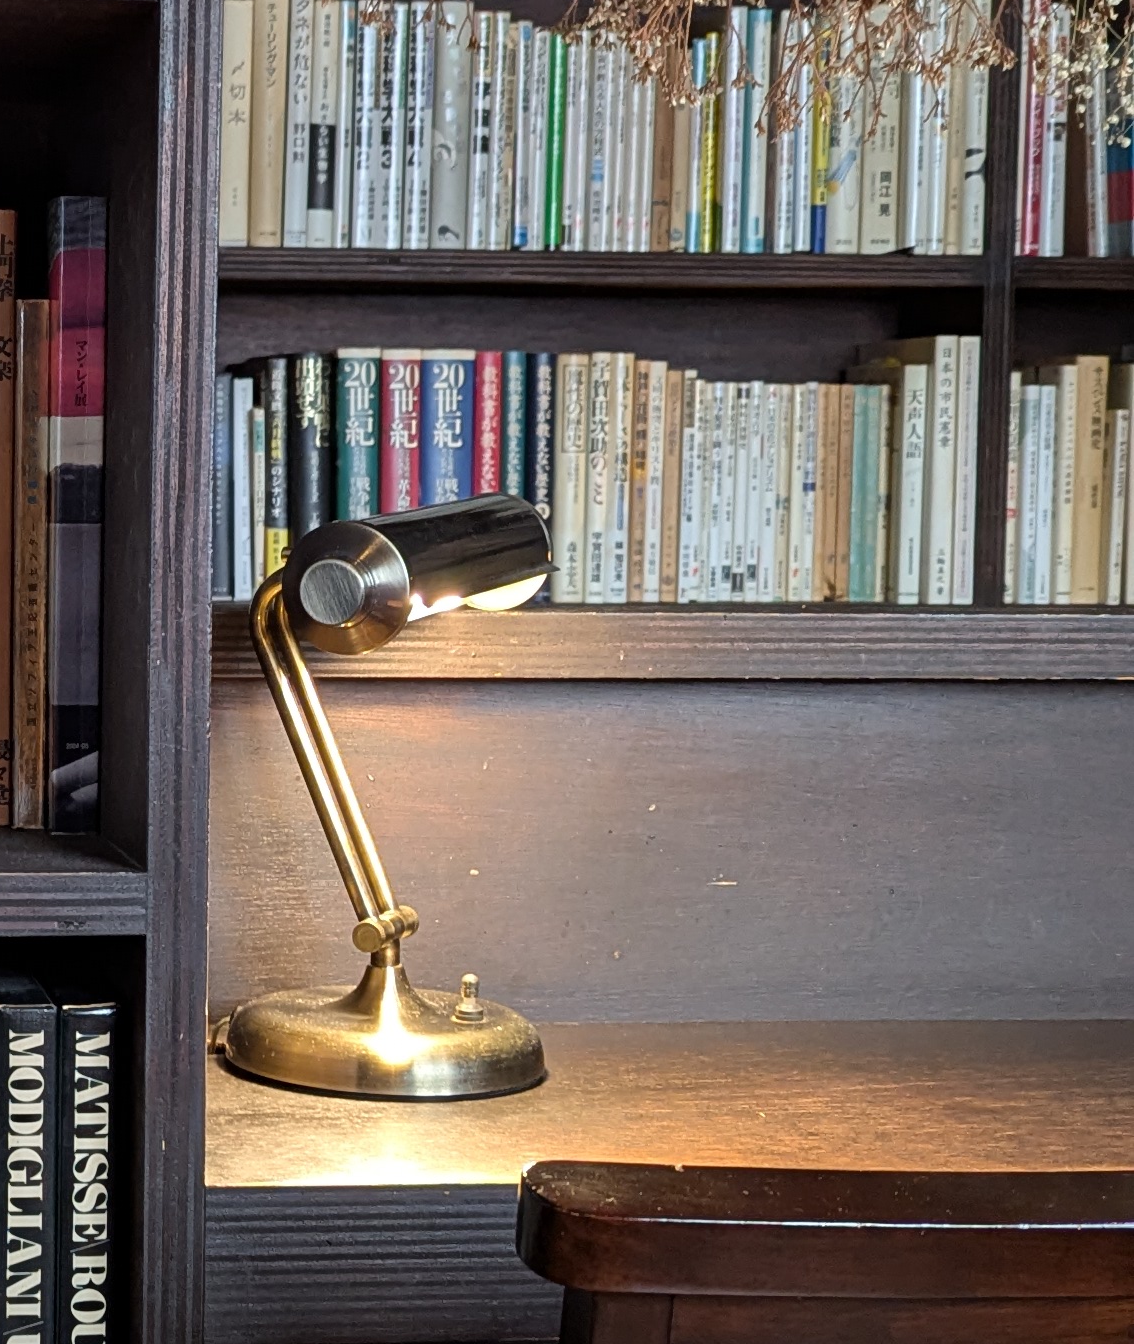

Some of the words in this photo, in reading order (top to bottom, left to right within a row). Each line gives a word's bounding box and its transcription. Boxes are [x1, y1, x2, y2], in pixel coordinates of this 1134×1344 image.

[74, 339, 89, 407] マン・レイ展
[344, 361, 377, 448] 20世紀
[432, 362, 466, 448] 20世紀
[938, 347, 953, 448] 日本の市民憲章
[905, 389, 923, 459] 天声人語
